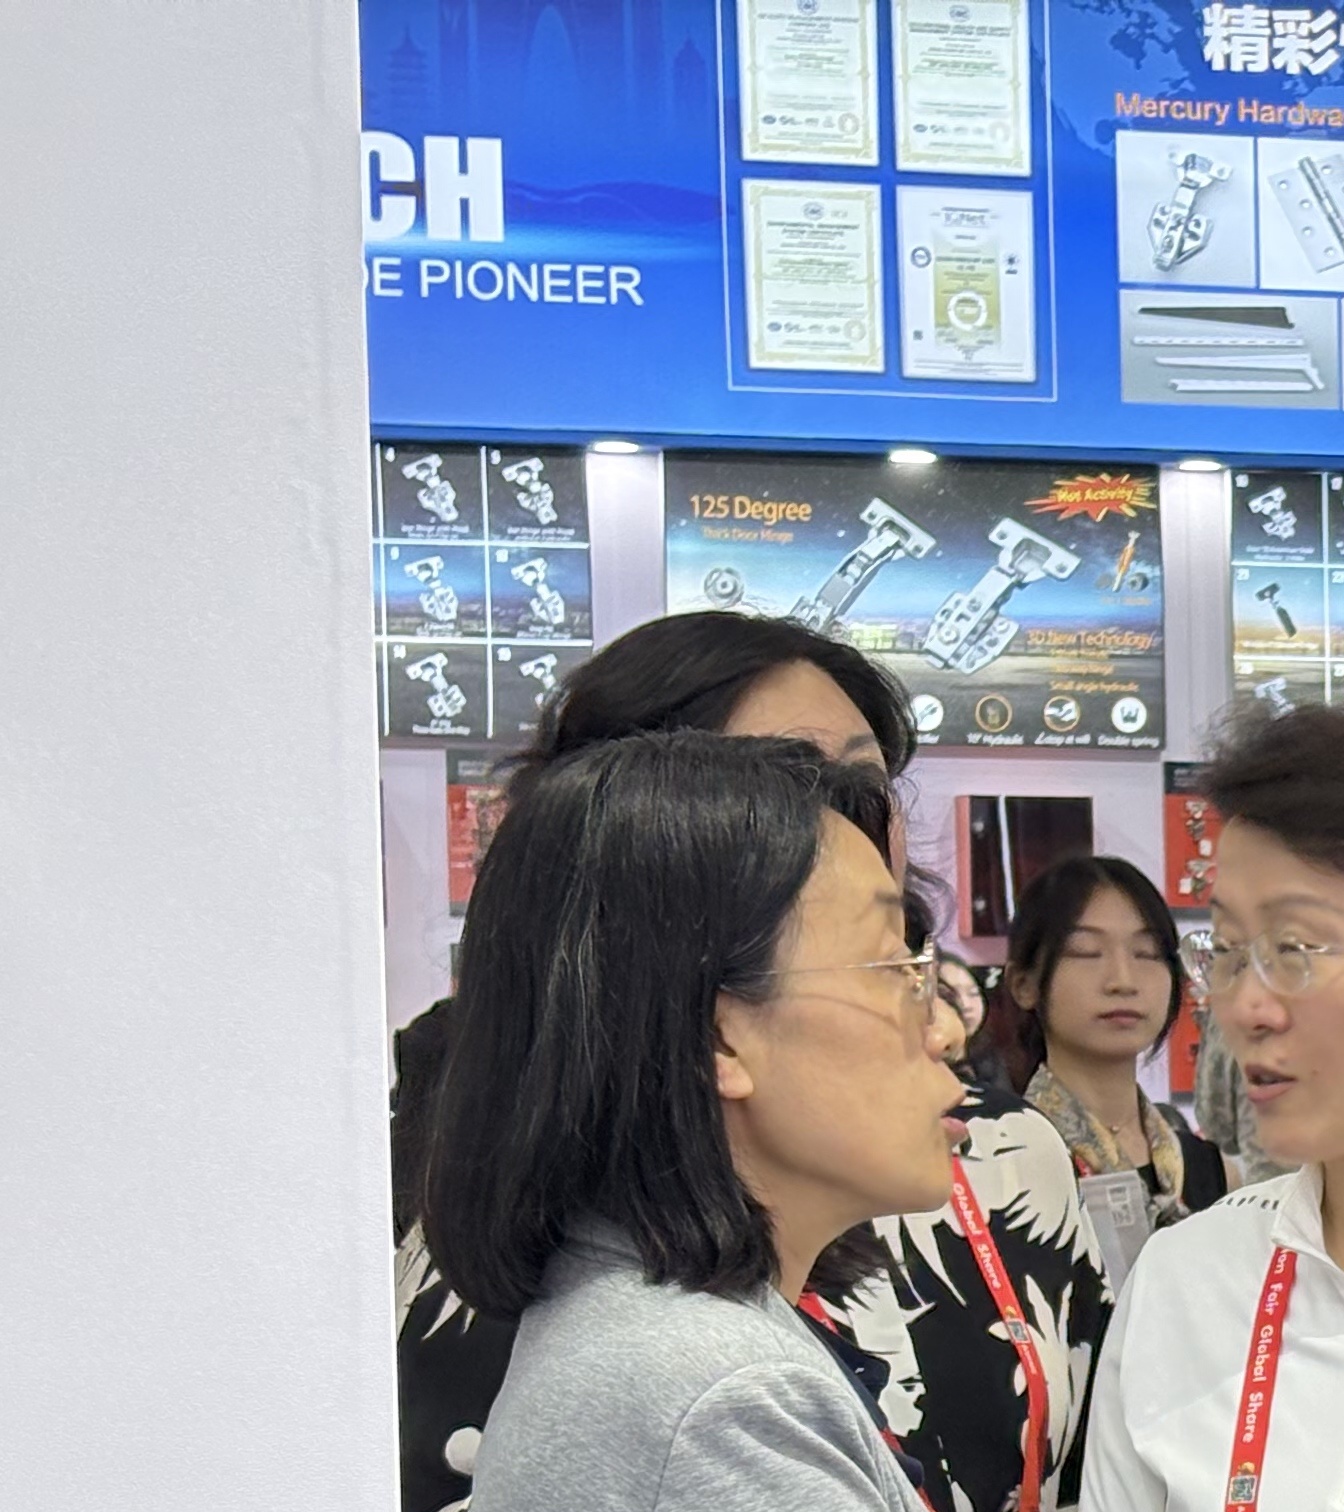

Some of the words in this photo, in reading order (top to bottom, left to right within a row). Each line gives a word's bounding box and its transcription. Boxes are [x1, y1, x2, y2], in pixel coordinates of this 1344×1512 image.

[1115, 93, 1229, 125] Mercury
[362, 257, 403, 297] E
[420, 259, 644, 306] PIONEER
[690, 494, 730, 519] 125
[733, 495, 813, 527] Degree
[952, 1182, 980, 1237] Global
[976, 1242, 1003, 1290] Share
[1262, 1281, 1284, 1316] Fair
[1252, 1324, 1274, 1384] Global
[1242, 1392, 1263, 1444] Share
